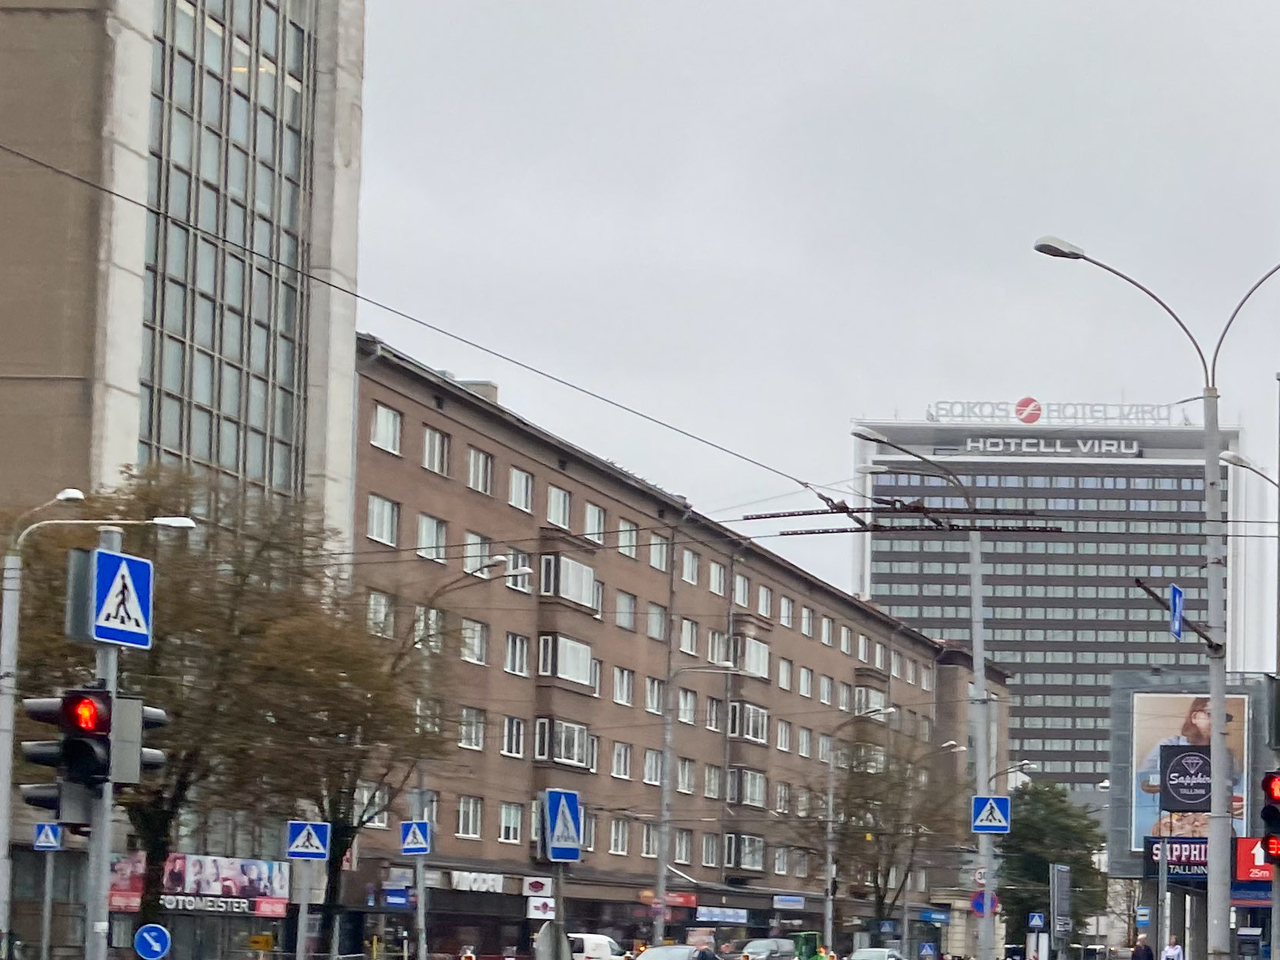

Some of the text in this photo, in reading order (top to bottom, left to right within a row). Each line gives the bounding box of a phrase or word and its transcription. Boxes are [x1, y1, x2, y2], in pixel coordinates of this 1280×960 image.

[935, 401, 1171, 423] SOKOS HOTEL VIRU
[966, 438, 1140, 454] HOTELL VIRU
[1249, 869, 1269, 878] 25m
